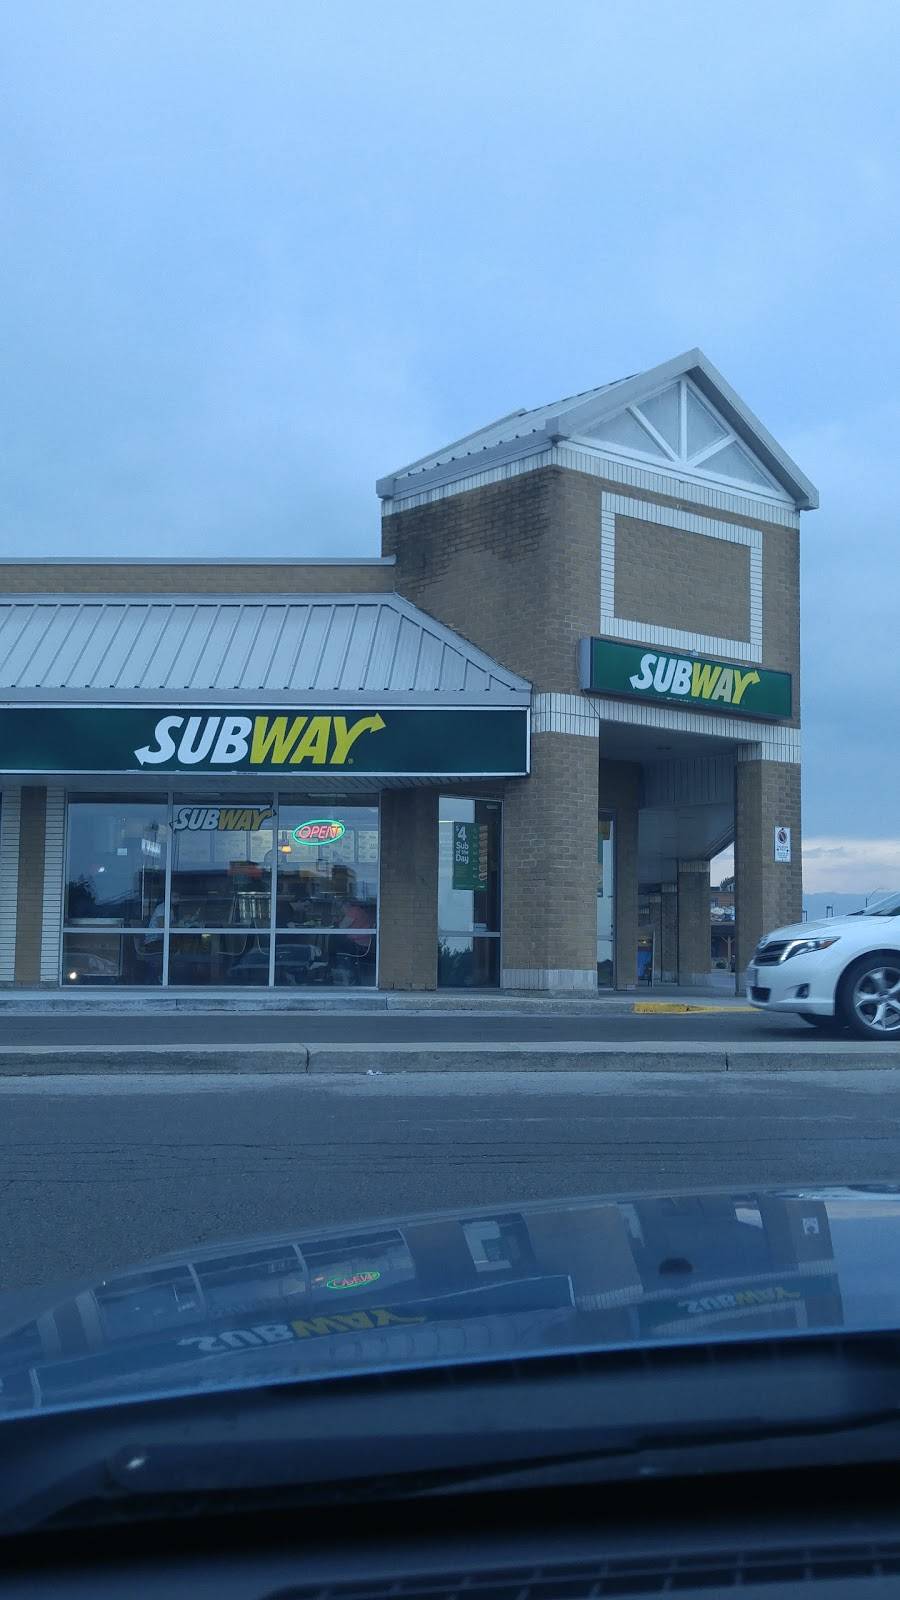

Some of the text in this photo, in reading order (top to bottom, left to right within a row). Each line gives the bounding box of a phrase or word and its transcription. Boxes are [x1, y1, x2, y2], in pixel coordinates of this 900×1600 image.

[629, 653, 761, 705] SUBWAY
[134, 712, 386, 766] SUBWAY
[170, 805, 277, 832] SUBWAY
[299, 825, 338, 839] OPEN
[456, 841, 469, 850] Sub
[456, 854, 469, 864] Day
